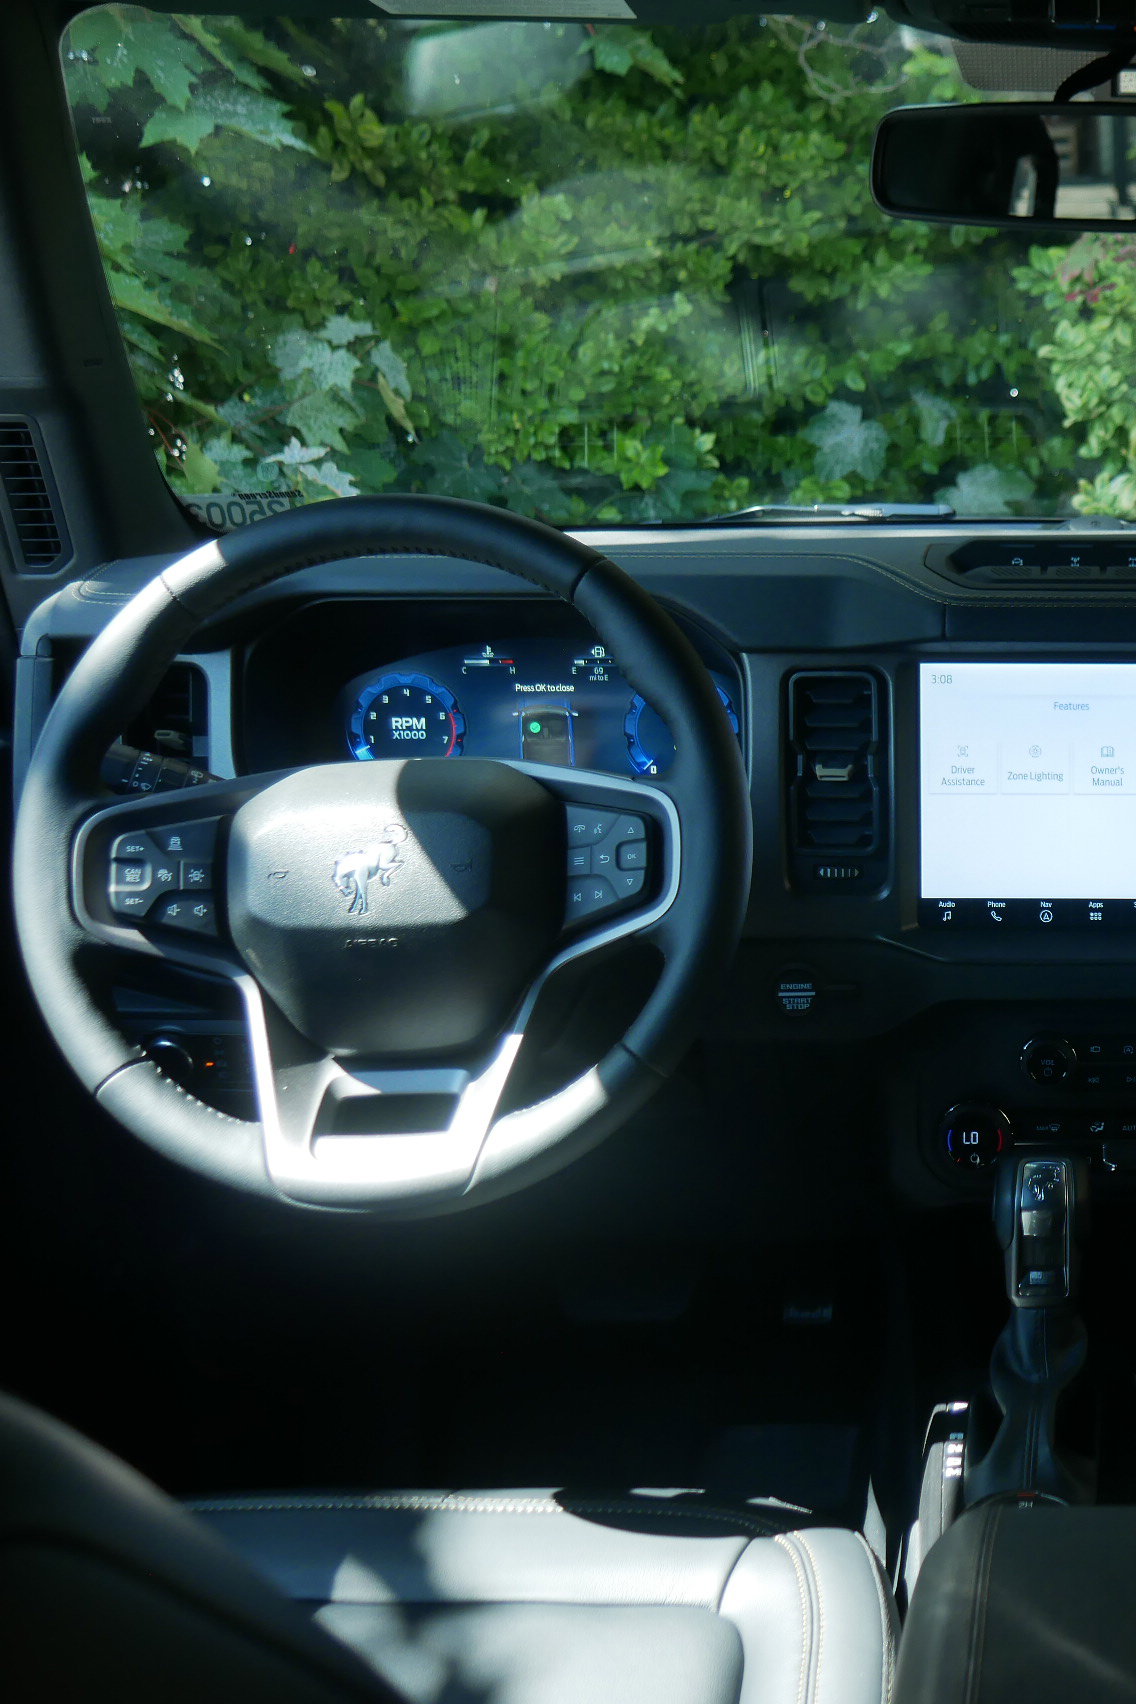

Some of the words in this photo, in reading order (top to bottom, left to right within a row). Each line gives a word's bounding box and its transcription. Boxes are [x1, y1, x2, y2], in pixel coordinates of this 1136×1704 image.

[594, 667, 604, 675] 69
[931, 674, 953, 685] 3:08
[515, 683, 535, 692] Press
[535, 683, 546, 692] OK
[548, 684, 556, 692] to
[556, 683, 575, 692] close
[403, 688, 410, 697] 4
[382, 695, 389, 704] 3
[425, 695, 432, 704] 5
[1053, 702, 1090, 711] Features
[370, 711, 377, 720] 2
[439, 712, 446, 720] 6
[391, 717, 426, 730] RPM
[392, 730, 426, 740] X1000
[951, 765, 976, 774] Driver
[1090, 765, 1125, 775] Owner's
[1007, 771, 1028, 781] Zone
[1029, 771, 1064, 782] Lighting
[941, 777, 986, 786] Assistance
[1092, 777, 1124, 787] Manual
[126, 845, 145, 853] SET+
[938, 900, 956, 908] Audio
[987, 900, 1006, 908] Phone
[1040, 900, 1053, 908] Nav
[1088, 900, 1104, 910] Apps
[1039, 1058, 1056, 1067] VOL
[962, 1131, 979, 1145] LO
